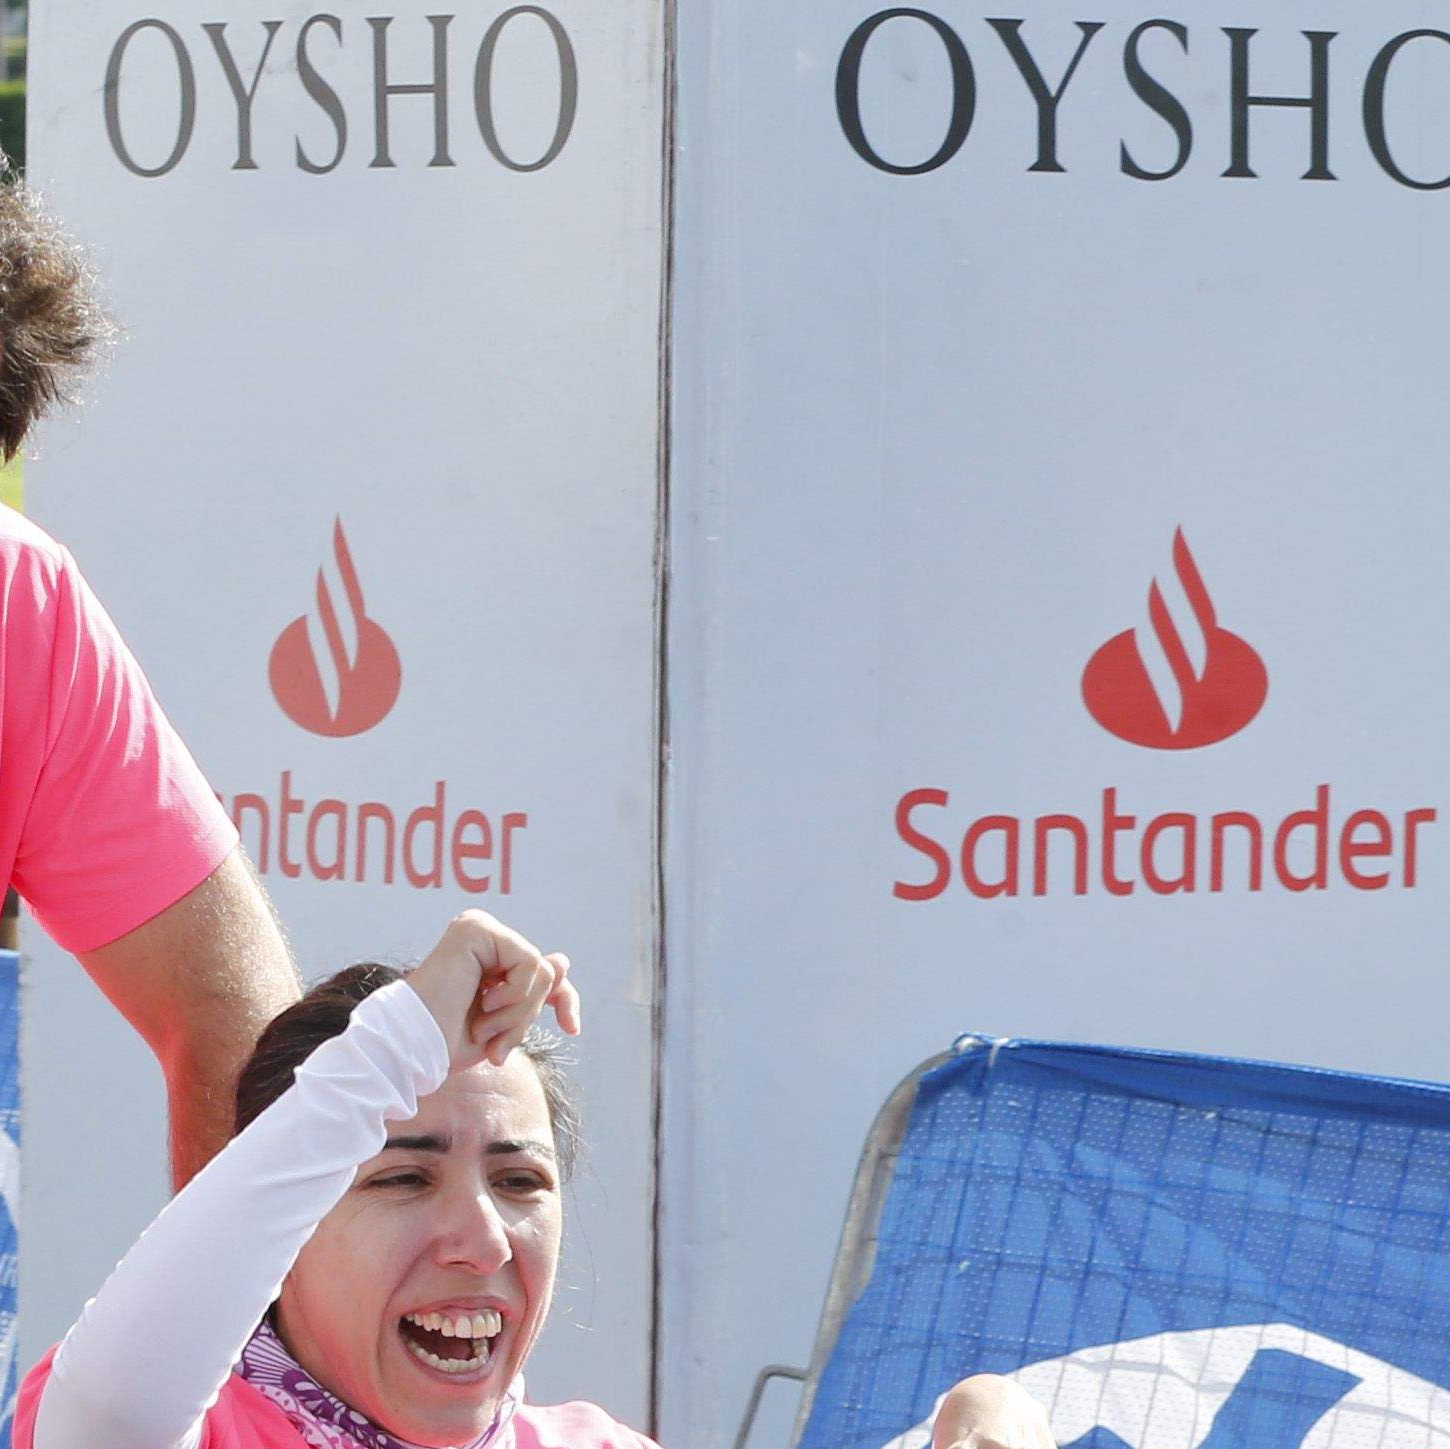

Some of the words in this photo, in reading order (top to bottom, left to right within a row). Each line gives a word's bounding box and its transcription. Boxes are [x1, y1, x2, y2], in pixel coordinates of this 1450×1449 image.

[104, 5, 578, 178] OYSHO
[229, 770, 528, 895] ntander
[893, 783, 1437, 901] Santander
